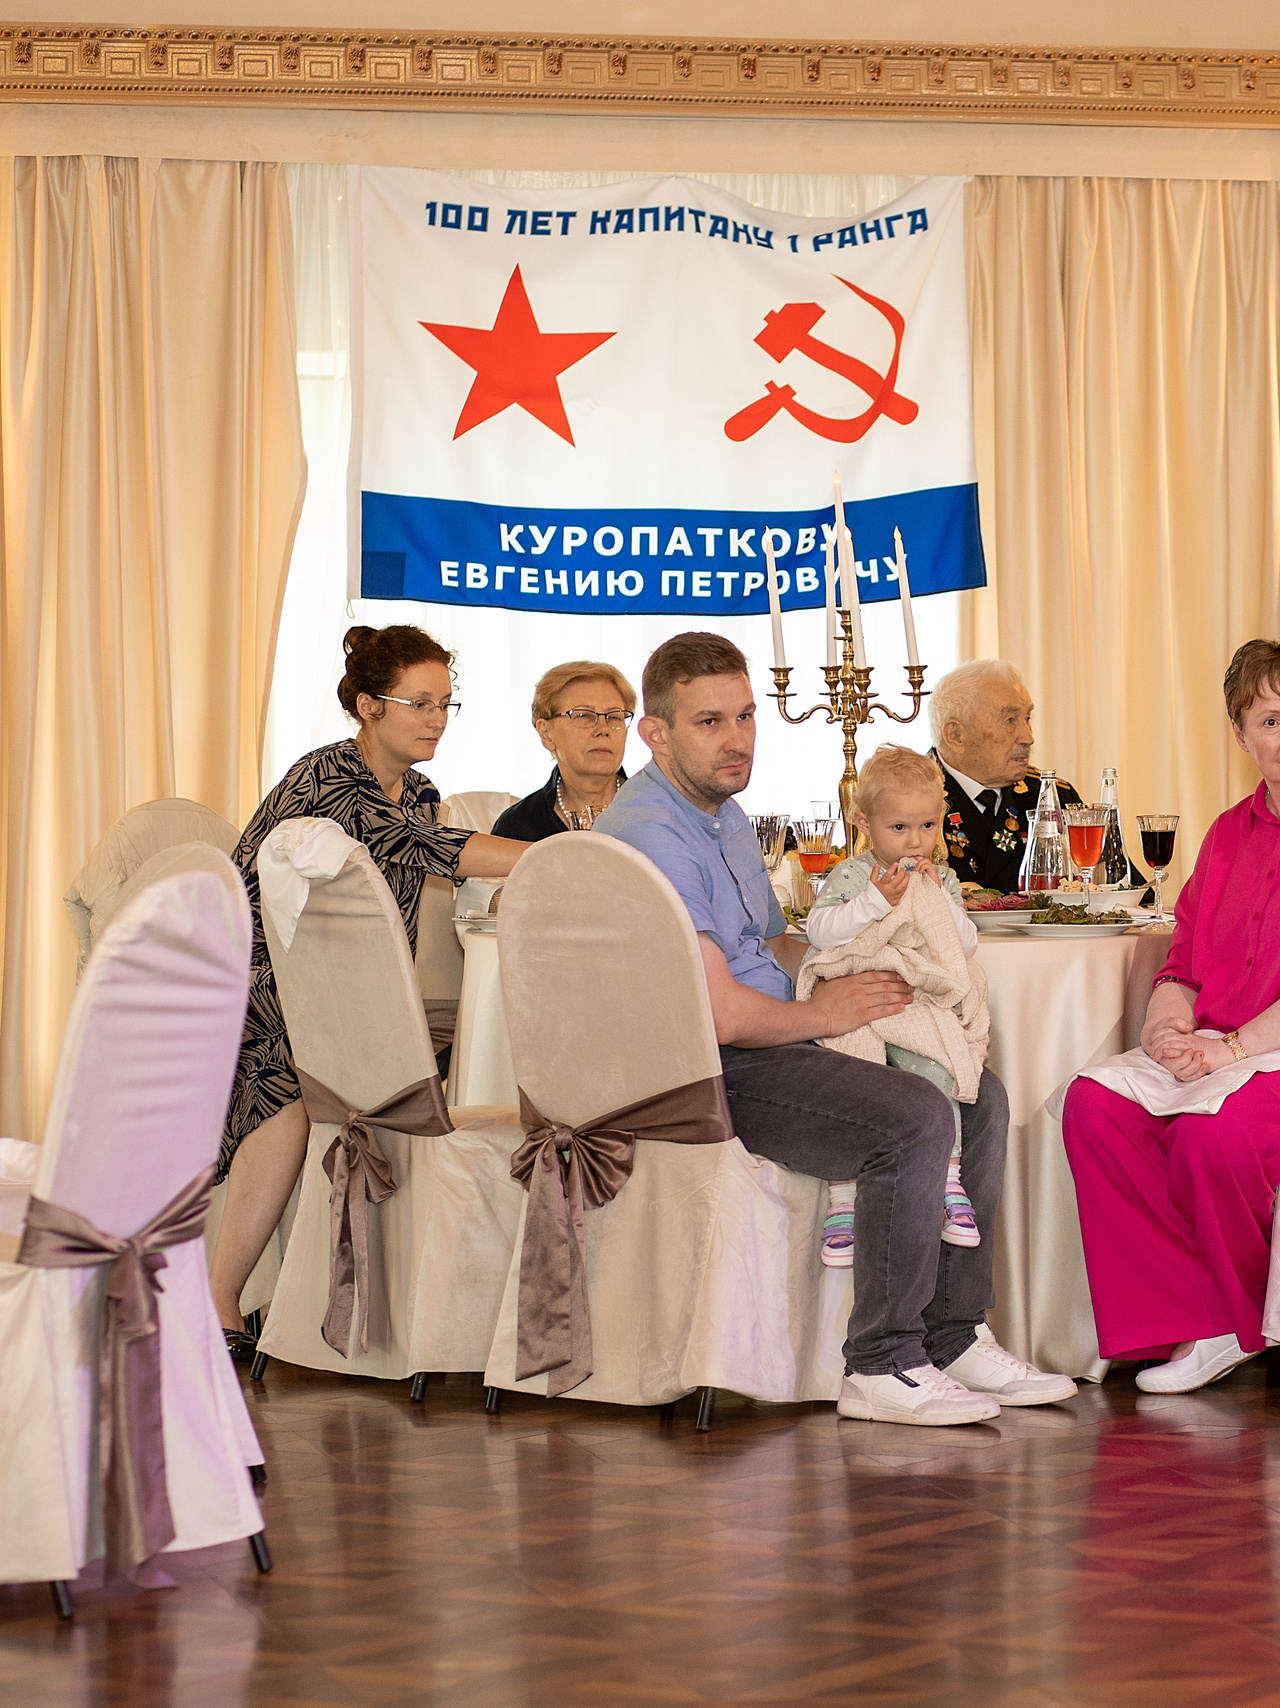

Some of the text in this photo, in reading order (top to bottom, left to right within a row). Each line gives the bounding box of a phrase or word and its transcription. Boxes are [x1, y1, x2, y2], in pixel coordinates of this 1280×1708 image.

[425, 201, 489, 232] 100
[504, 208, 577, 236] ЛЕТ
[589, 205, 774, 250] КАПИТАНУ
[812, 207, 929, 252] РАНГА
[440, 560, 645, 597] ЕВГЕНИЮ
